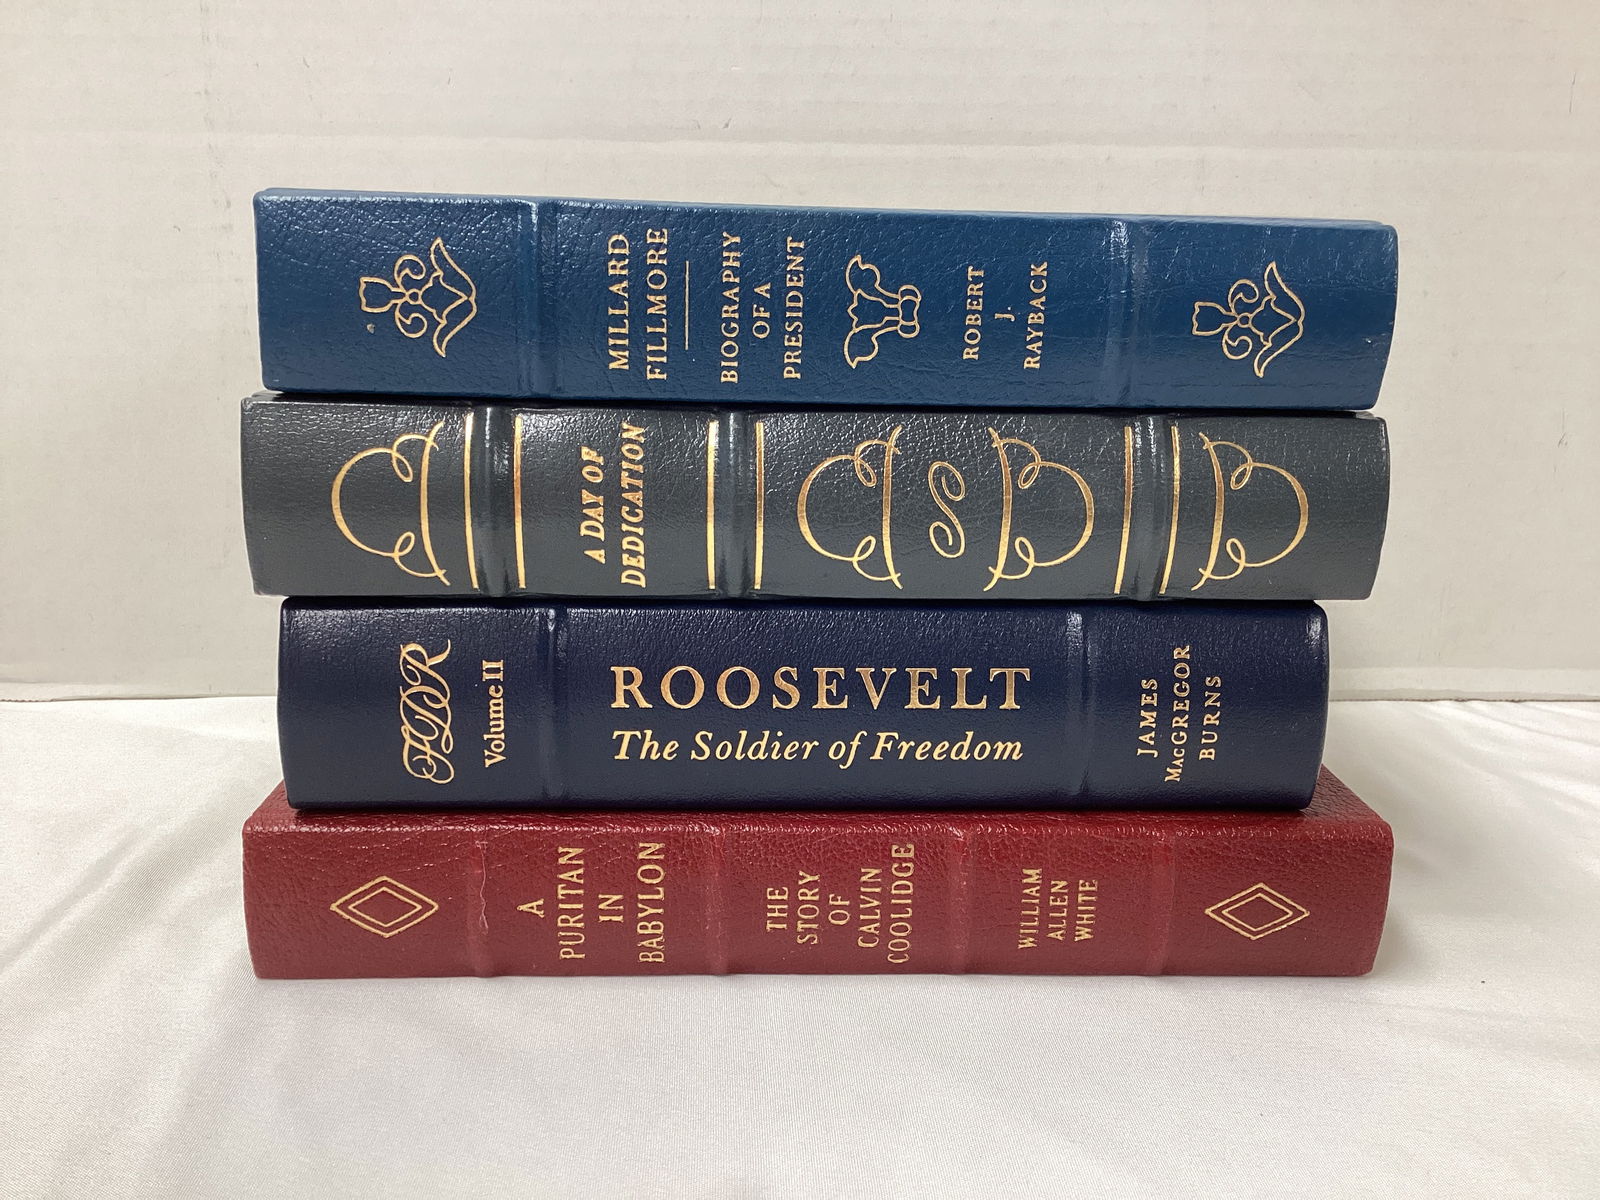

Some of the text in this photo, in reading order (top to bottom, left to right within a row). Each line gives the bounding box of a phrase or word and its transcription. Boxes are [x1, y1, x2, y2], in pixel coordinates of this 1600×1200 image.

[608, 233, 631, 370] MILLARD
[646, 227, 668, 382] FILLMORE
[720, 232, 742, 384] BIOGRAPHY
[752, 282, 772, 339] OF A
[783, 236, 806, 380] PRESIDENT
[962, 266, 985, 361] ROBERT
[994, 306, 1016, 322] J.
[1023, 261, 1048, 370] RAYBACK
[580, 446, 606, 563] A DAY OF
[620, 422, 646, 588] DEDICATION
[483, 659, 506, 768] Volume II
[610, 665, 1031, 710] ROOSEVELT
[1137, 678, 1158, 758] JAMES
[1198, 675, 1222, 761] BURNS
[612, 730, 1024, 769] The Soldier of Freedom
[517, 899, 545, 918] A
[557, 846, 586, 960] PURITAN
[598, 893, 624, 922] IN
[637, 842, 666, 963] BABYLON
[766, 886, 788, 932] THE
[796, 870, 820, 945] STORY
[828, 893, 851, 926] OF
[857, 867, 883, 948] CALVIN
[887, 843, 915, 963] COOLIDGE
[1018, 867, 1042, 949] WILLIAM
[1047, 880, 1069, 941] ALLEN
[1074, 879, 1098, 942] WHITE
